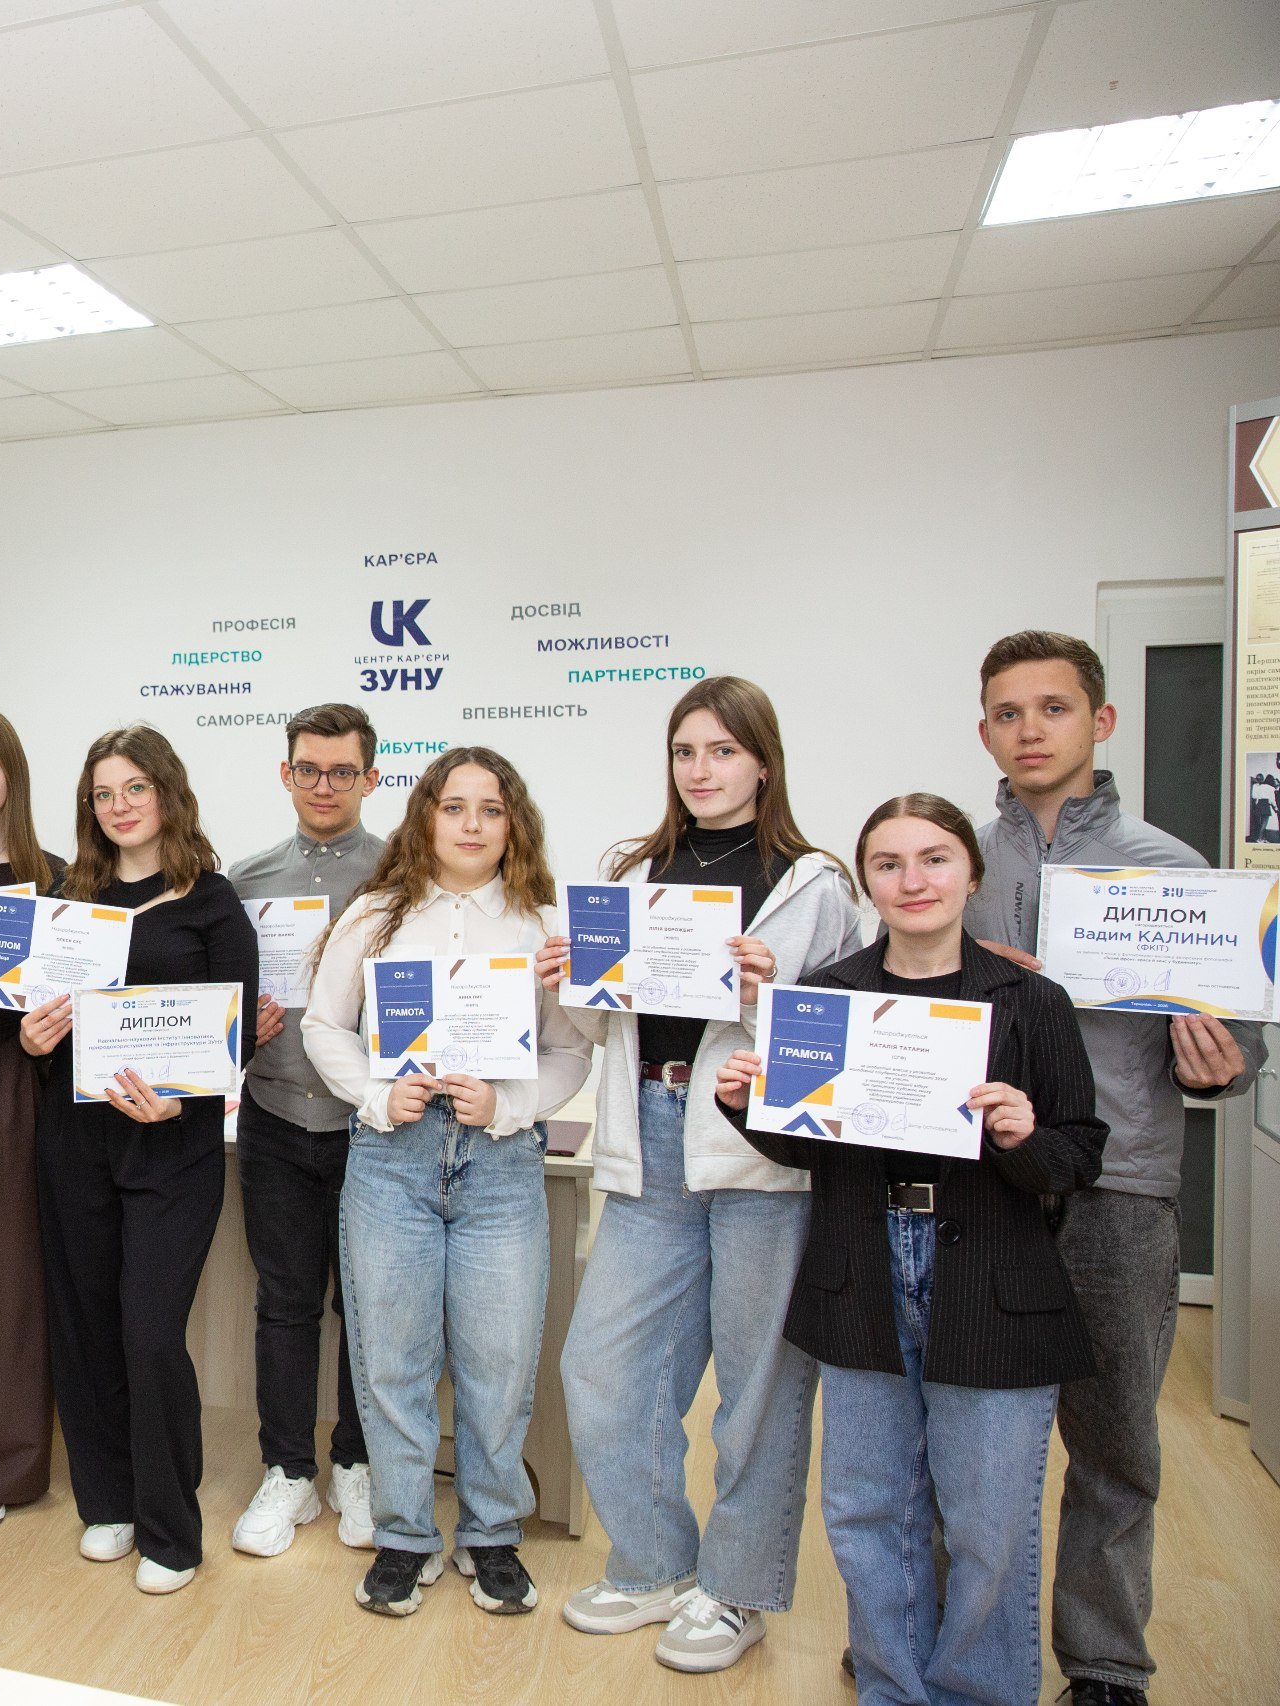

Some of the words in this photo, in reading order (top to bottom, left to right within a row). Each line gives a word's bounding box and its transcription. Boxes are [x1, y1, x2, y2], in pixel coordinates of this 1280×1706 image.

[510, 602, 581, 621] ДОСВІД
[212, 617, 296, 633] ПРОФЕСІЯ
[537, 635, 669, 652] МОЖЛИВОСТІ
[171, 650, 262, 667] ЛІДЕРСТВО
[354, 656, 393, 665] ЦЕНТР
[360, 667, 444, 692] ЗУНУ
[568, 665, 706, 684] ПАРТНЕРСТВО
[139, 681, 252, 698] СТАЖУВАННЯ
[196, 712, 296, 727] САМОРЕАЛІ
[462, 704, 588, 720] ВПЕВНЕНІСТЬ
[374, 739, 449, 754] ЙБУТНЄ
[1103, 906, 1206, 924] ДИПЛОМ
[577, 933, 621, 945] ГРАМОТА
[1073, 927, 1131, 943] Вадим
[1138, 930, 1238, 947] КАЛИНИЧ
[1136, 944, 1169, 952] (ФКІТ)
[385, 1008, 425, 1017] ГРАМОТА
[120, 1015, 191, 1031] ДИПЛОМ
[778, 1046, 834, 1062] ГРАМОТА
[869, 1042, 898, 1050] НАТАЛІЯ
[899, 1045, 930, 1053] ТАТАРИН
